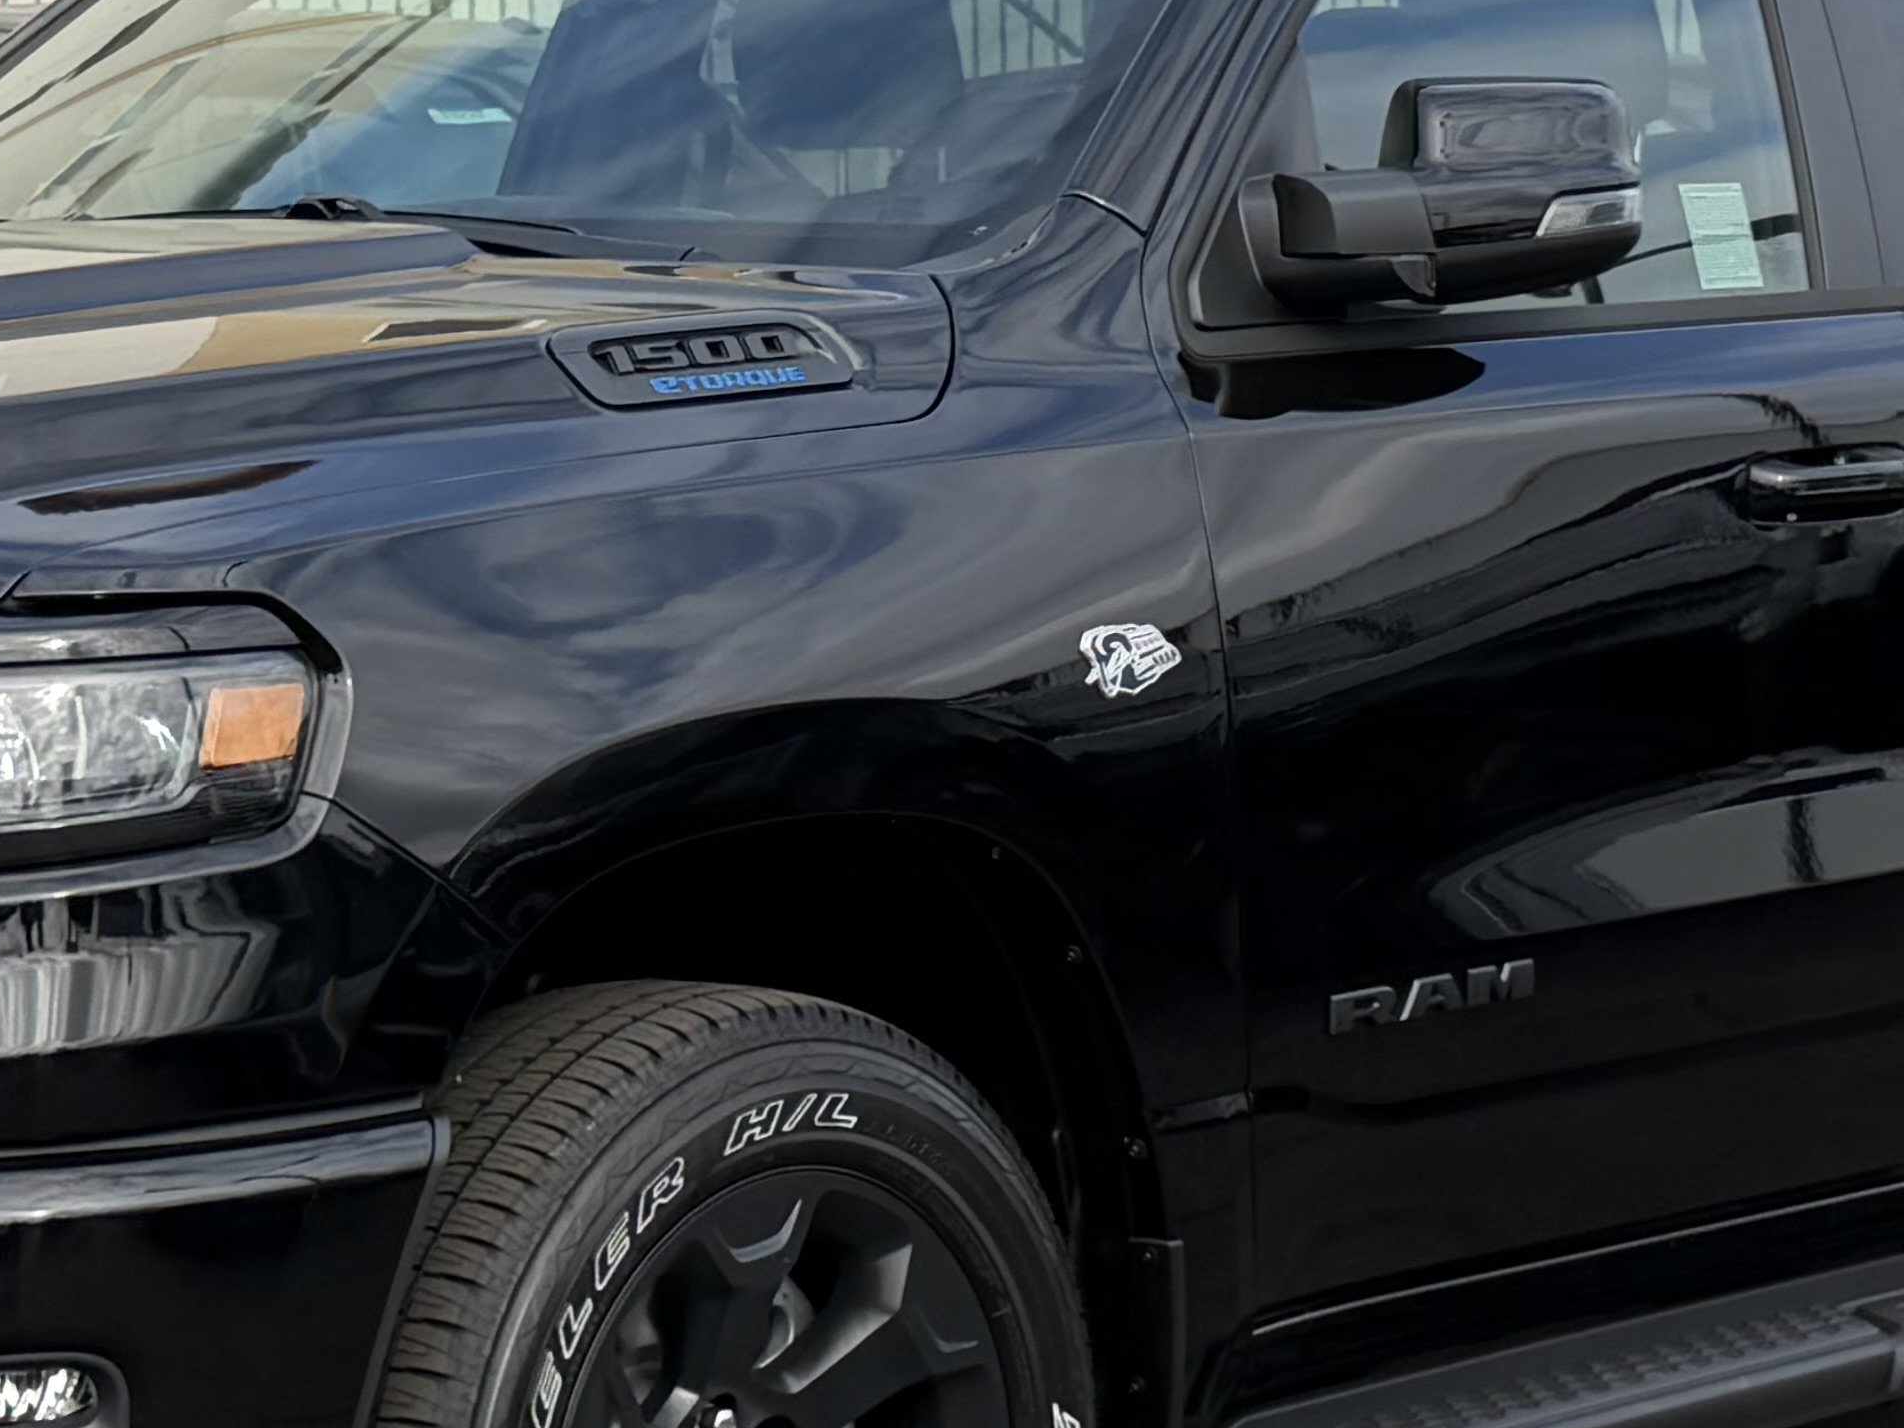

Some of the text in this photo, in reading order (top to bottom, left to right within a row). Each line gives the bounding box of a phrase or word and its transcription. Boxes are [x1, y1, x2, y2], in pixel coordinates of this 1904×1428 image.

[595, 331, 794, 374] 1500
[1329, 958, 1534, 1036] RAM
[723, 1093, 858, 1156] H/L
